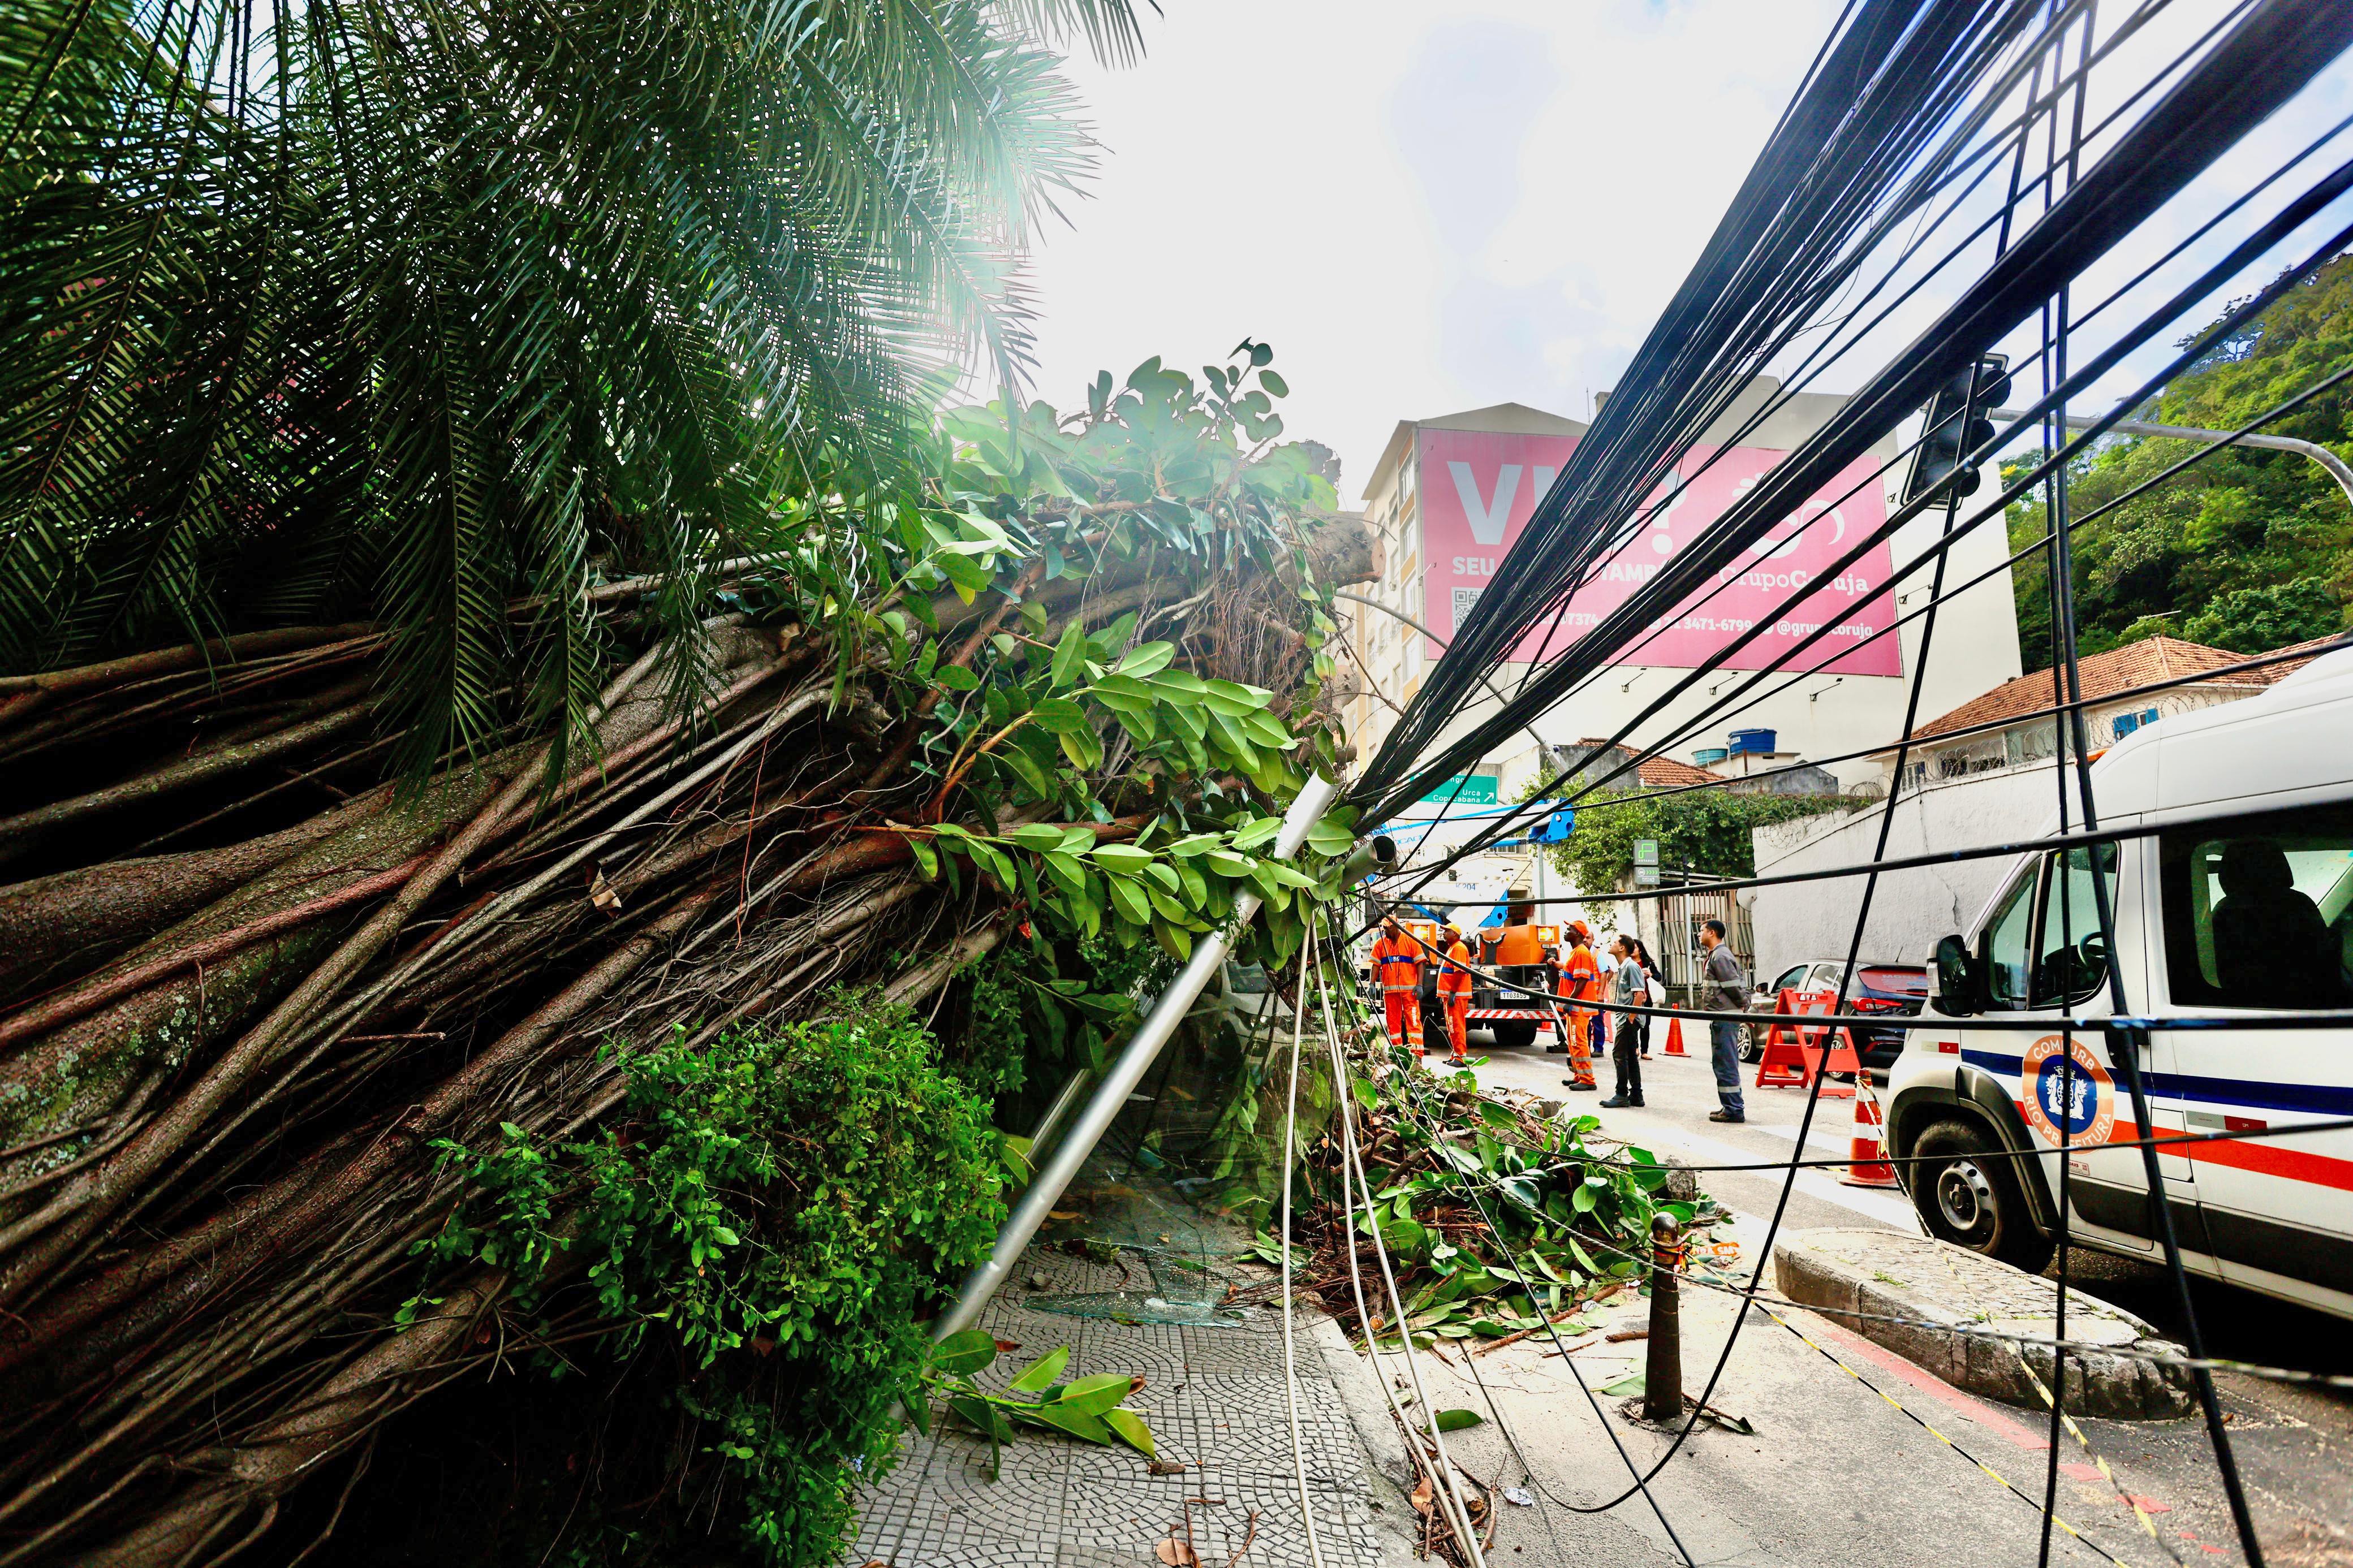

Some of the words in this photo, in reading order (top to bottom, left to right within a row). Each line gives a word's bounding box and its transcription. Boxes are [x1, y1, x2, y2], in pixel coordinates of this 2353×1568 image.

[1452, 556, 1496, 576] SEU
[1683, 617, 1753, 632] 3471-6799
[2024, 1095, 2042, 1124] RIO
[2043, 1113, 2111, 1146] PRFEITURA
